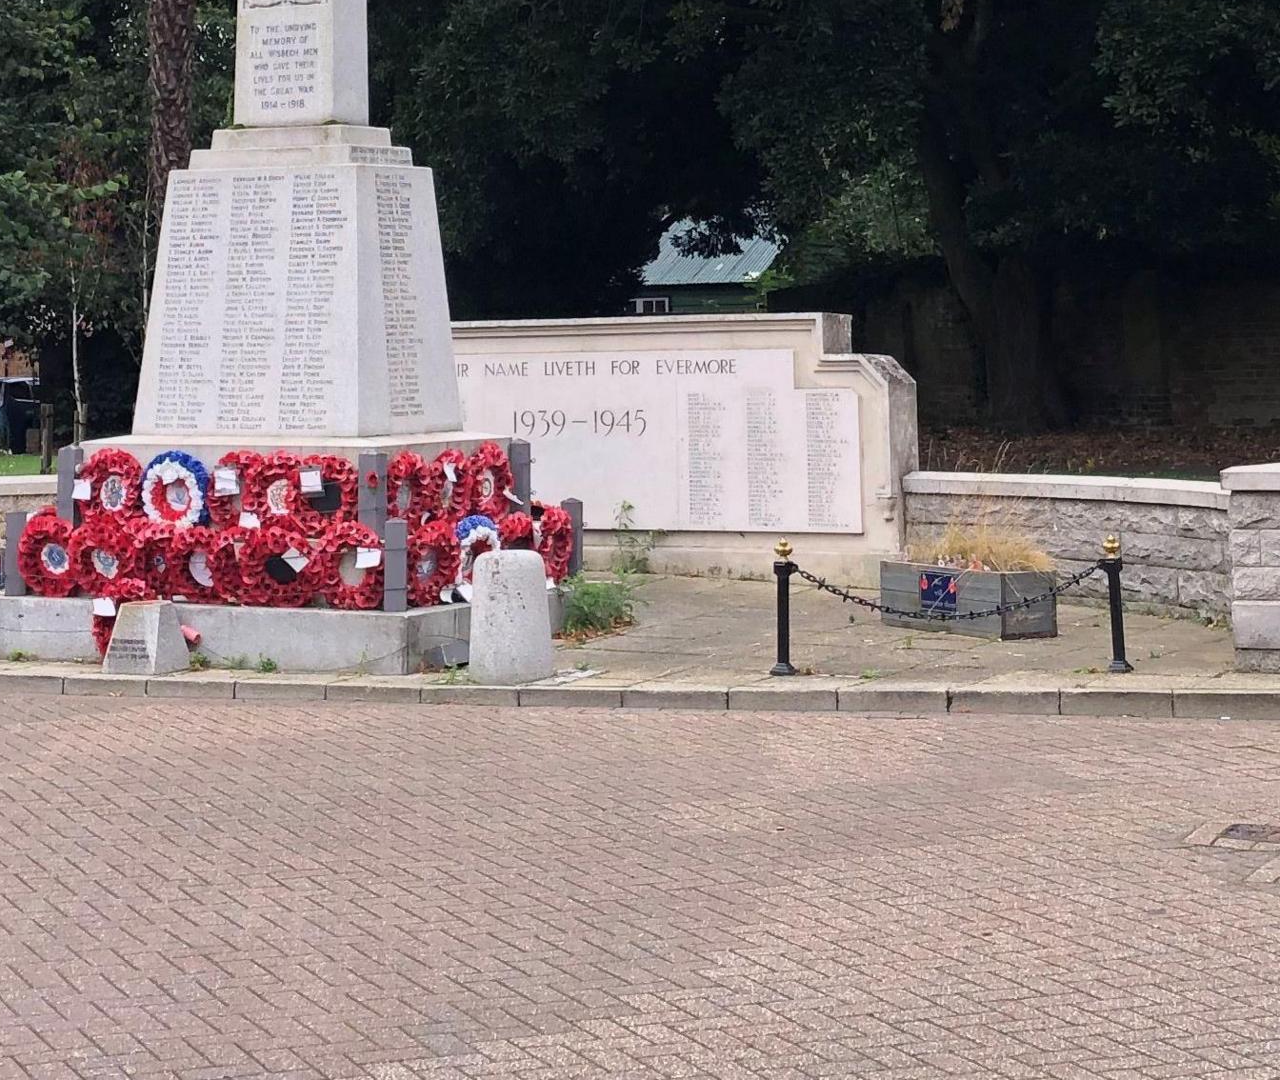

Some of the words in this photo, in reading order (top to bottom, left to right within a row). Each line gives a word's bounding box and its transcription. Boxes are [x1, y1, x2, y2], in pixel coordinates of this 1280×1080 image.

[266, 24, 279, 33] THE
[262, 36, 297, 46] MEMORY
[299, 35, 308, 44] OF
[303, 48, 318, 56] MEN
[278, 74, 291, 83] FOR
[254, 87, 267, 97] THE
[271, 86, 294, 96] GREAT
[298, 85, 314, 94] WAR
[484, 361, 529, 378] NAME
[543, 360, 596, 376] LIVETH
[610, 360, 640, 376] FOR
[656, 359, 737, 376] EVERMORE
